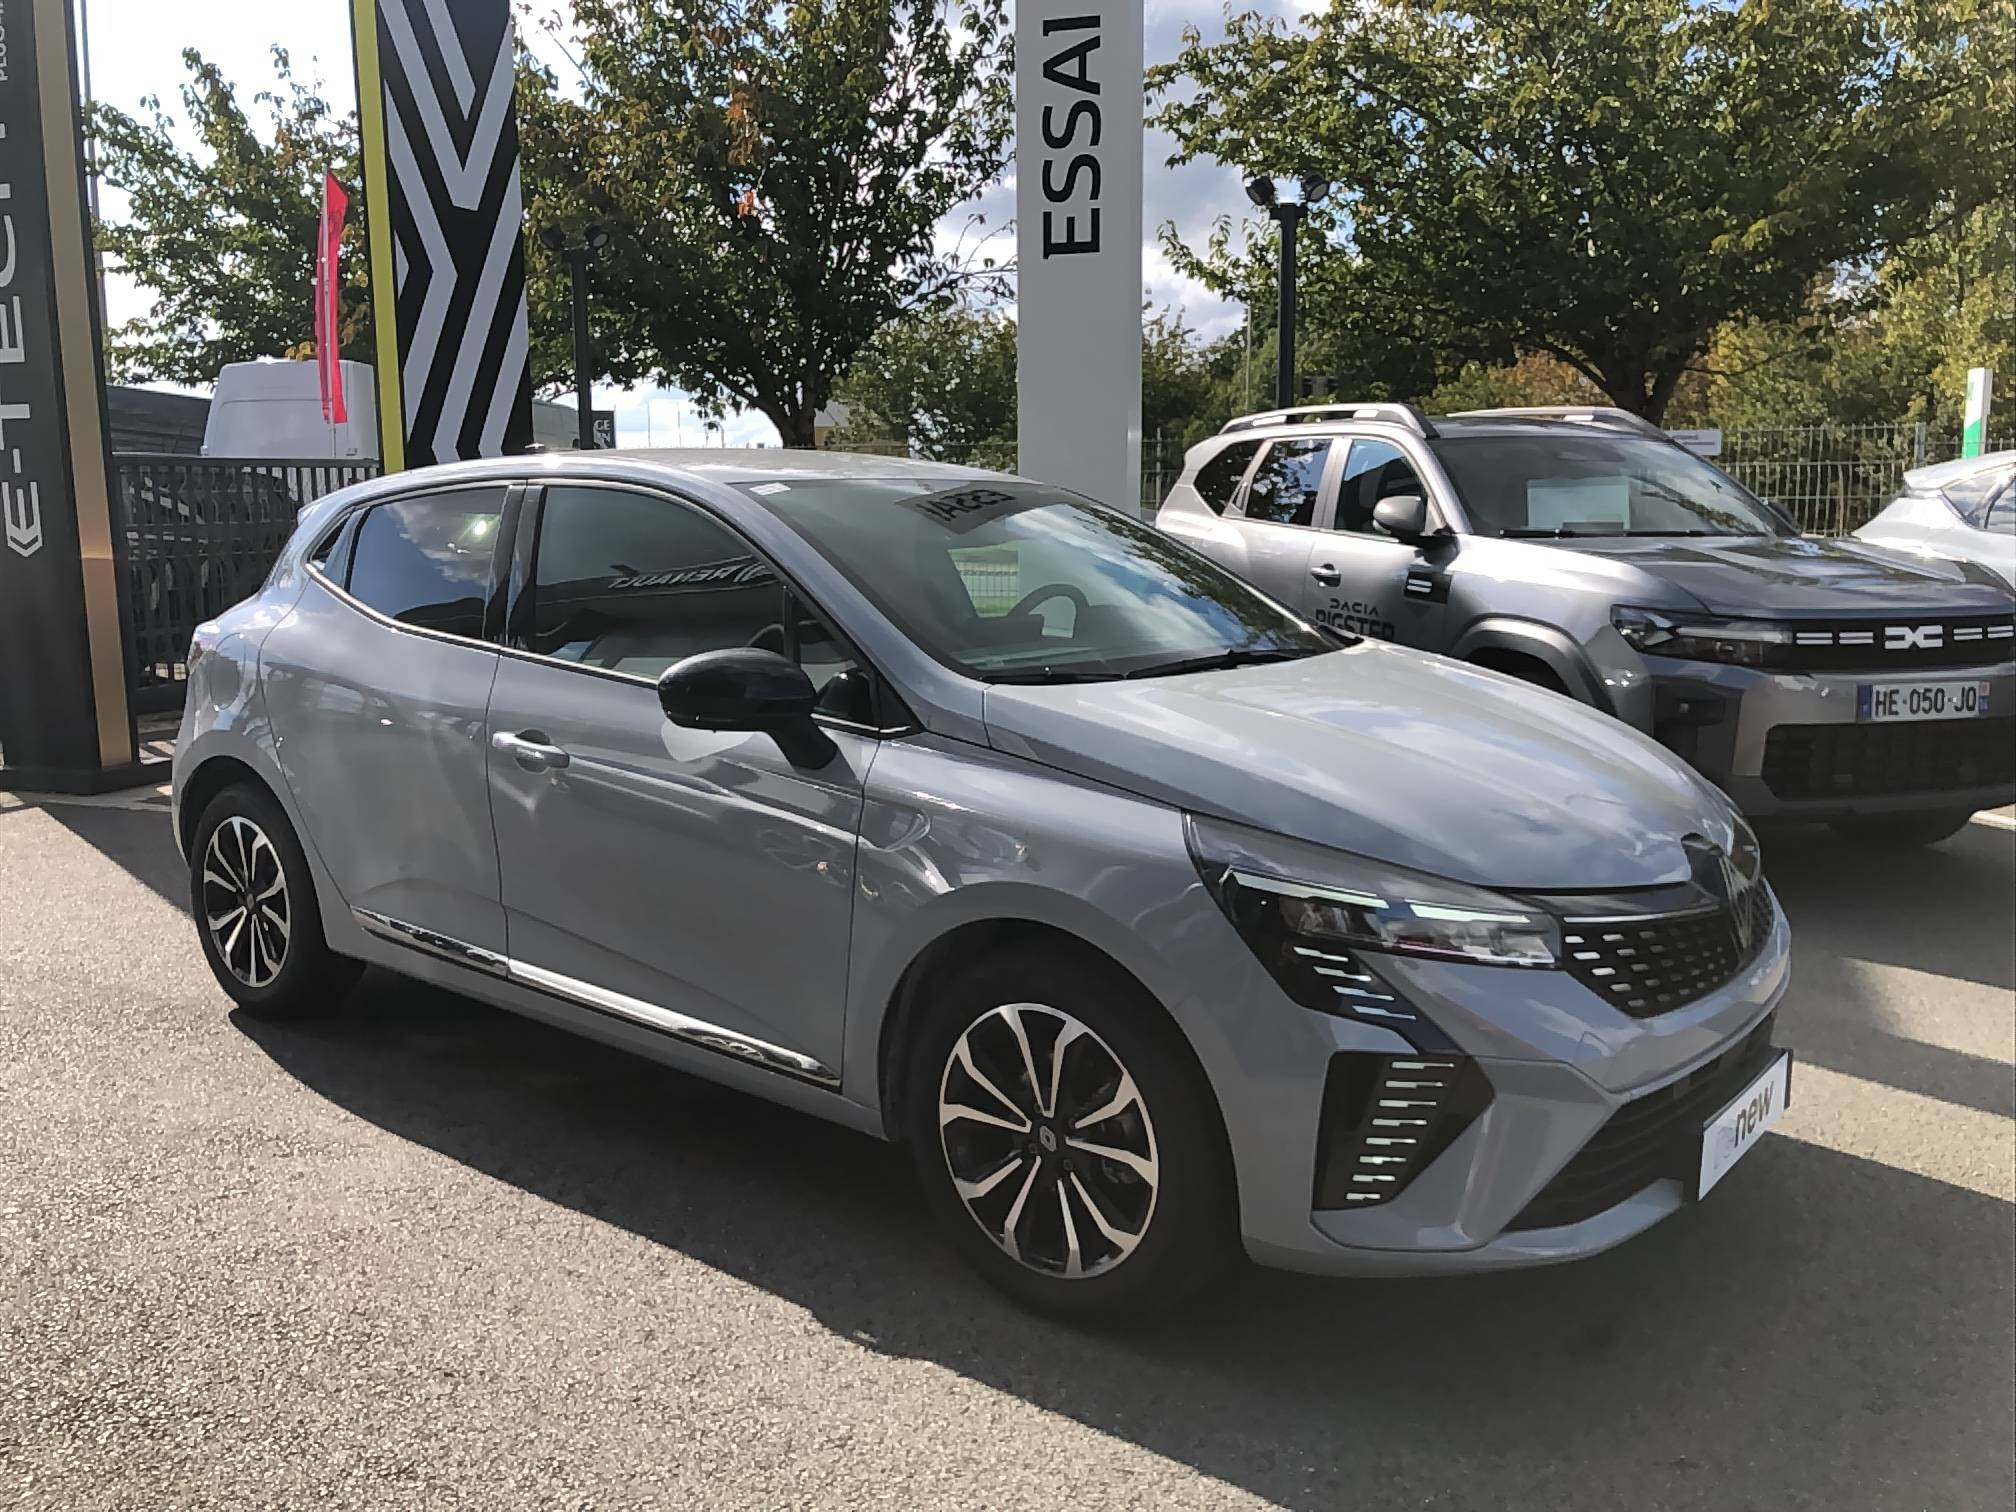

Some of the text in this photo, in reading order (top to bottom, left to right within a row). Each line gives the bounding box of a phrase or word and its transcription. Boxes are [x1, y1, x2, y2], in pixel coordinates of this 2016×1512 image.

[1042, 15, 1101, 260] ESSAI
[0, 122, 42, 557] E-TE
[1329, 598, 1379, 617] DACIA
